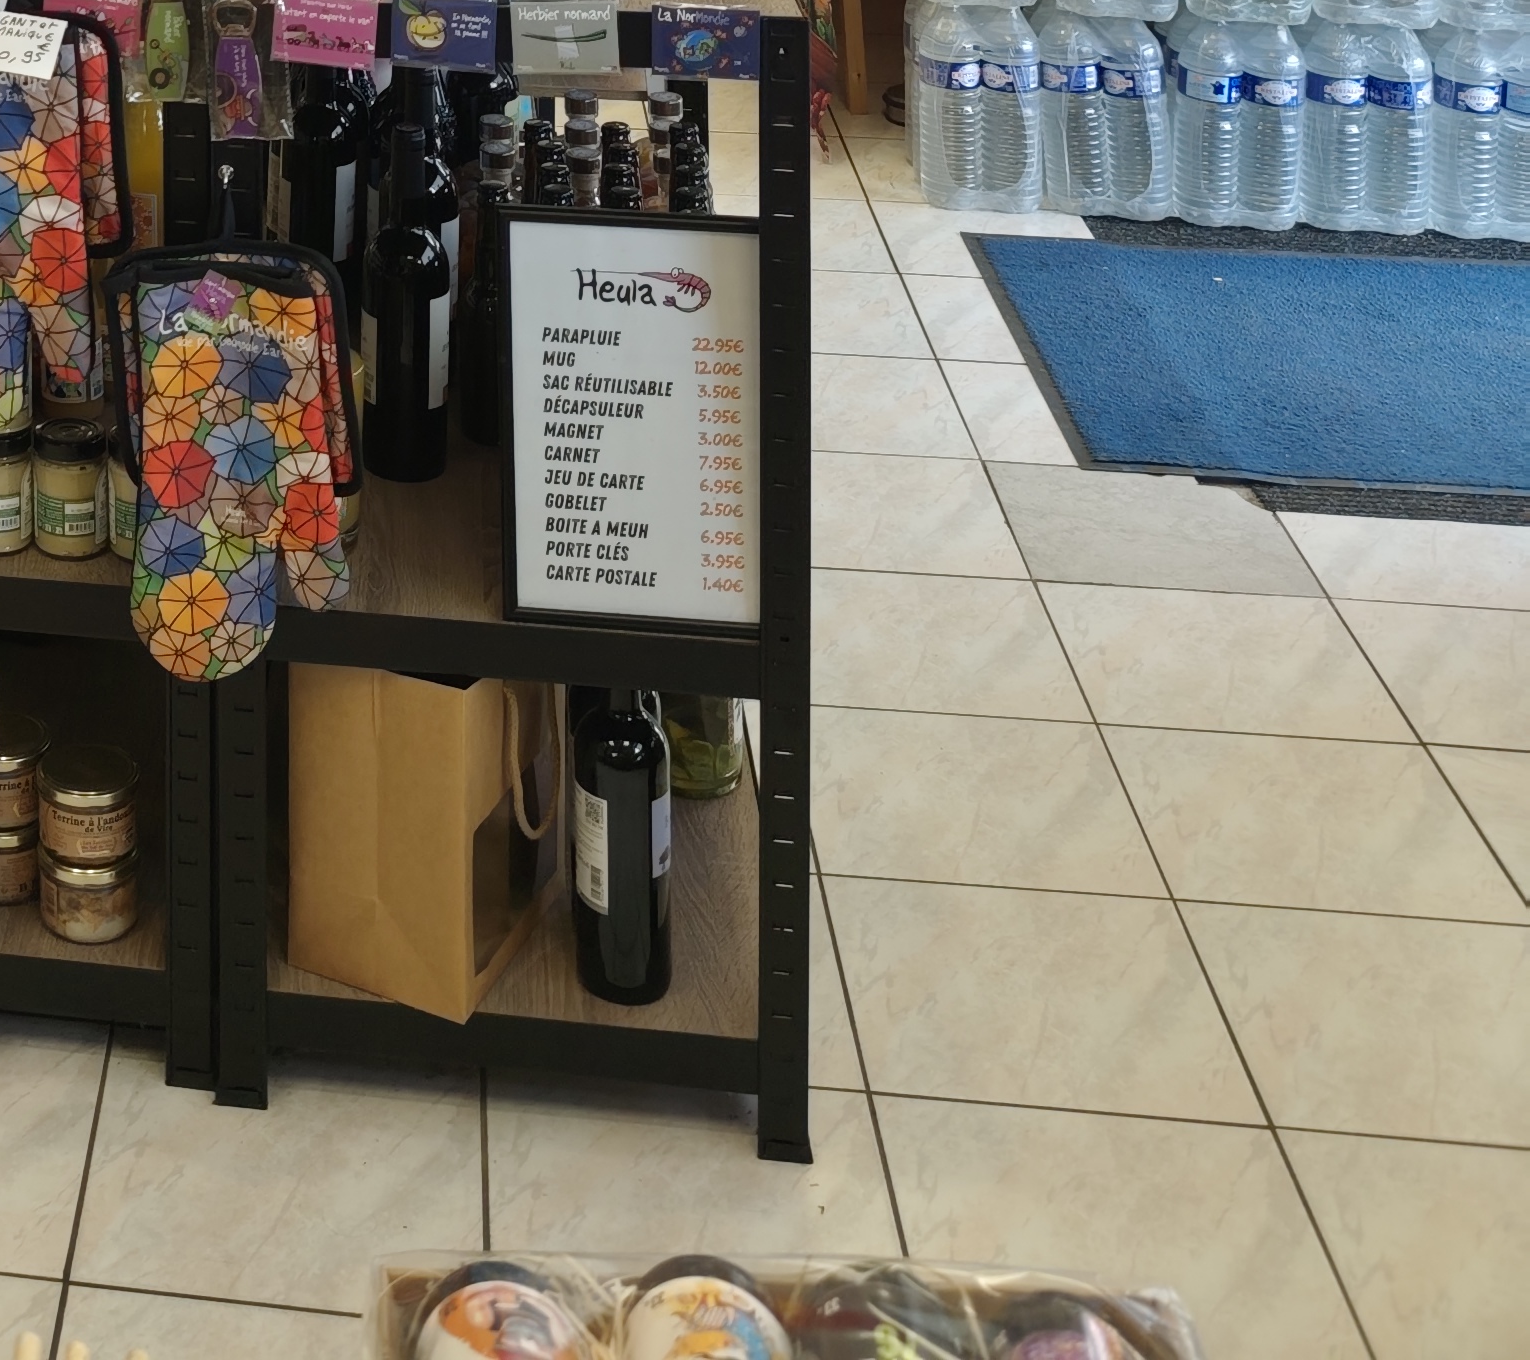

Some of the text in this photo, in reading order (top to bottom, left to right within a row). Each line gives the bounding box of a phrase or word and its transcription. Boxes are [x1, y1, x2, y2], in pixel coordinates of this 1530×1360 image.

[519, 4, 611, 21] Herbier normand
[658, 9, 673, 22] La
[576, 268, 657, 306] Heula
[159, 308, 189, 336] La
[542, 327, 744, 353] PARAPLUIE 22.95€
[542, 351, 743, 376] MUG 12.00€
[542, 373, 742, 400] SAC RÉUTILISABLE 3.50€
[543, 395, 742, 424] DÉCAPSULEUR 5.95€
[543, 422, 743, 448] MAGNET 3.00€
[544, 445, 743, 471] CARNET 7.95€
[544, 469, 744, 495] JEU DE CARTE 6.95€
[545, 493, 744, 518] GOBELET 2.50€
[545, 516, 745, 546] BOITE A MEUH 6.95€
[545, 541, 746, 570] PORTE CLÉS 3.95€
[546, 564, 745, 593] CARTE POSTALE 1.40€
[51, 809, 86, 827] Terrine
